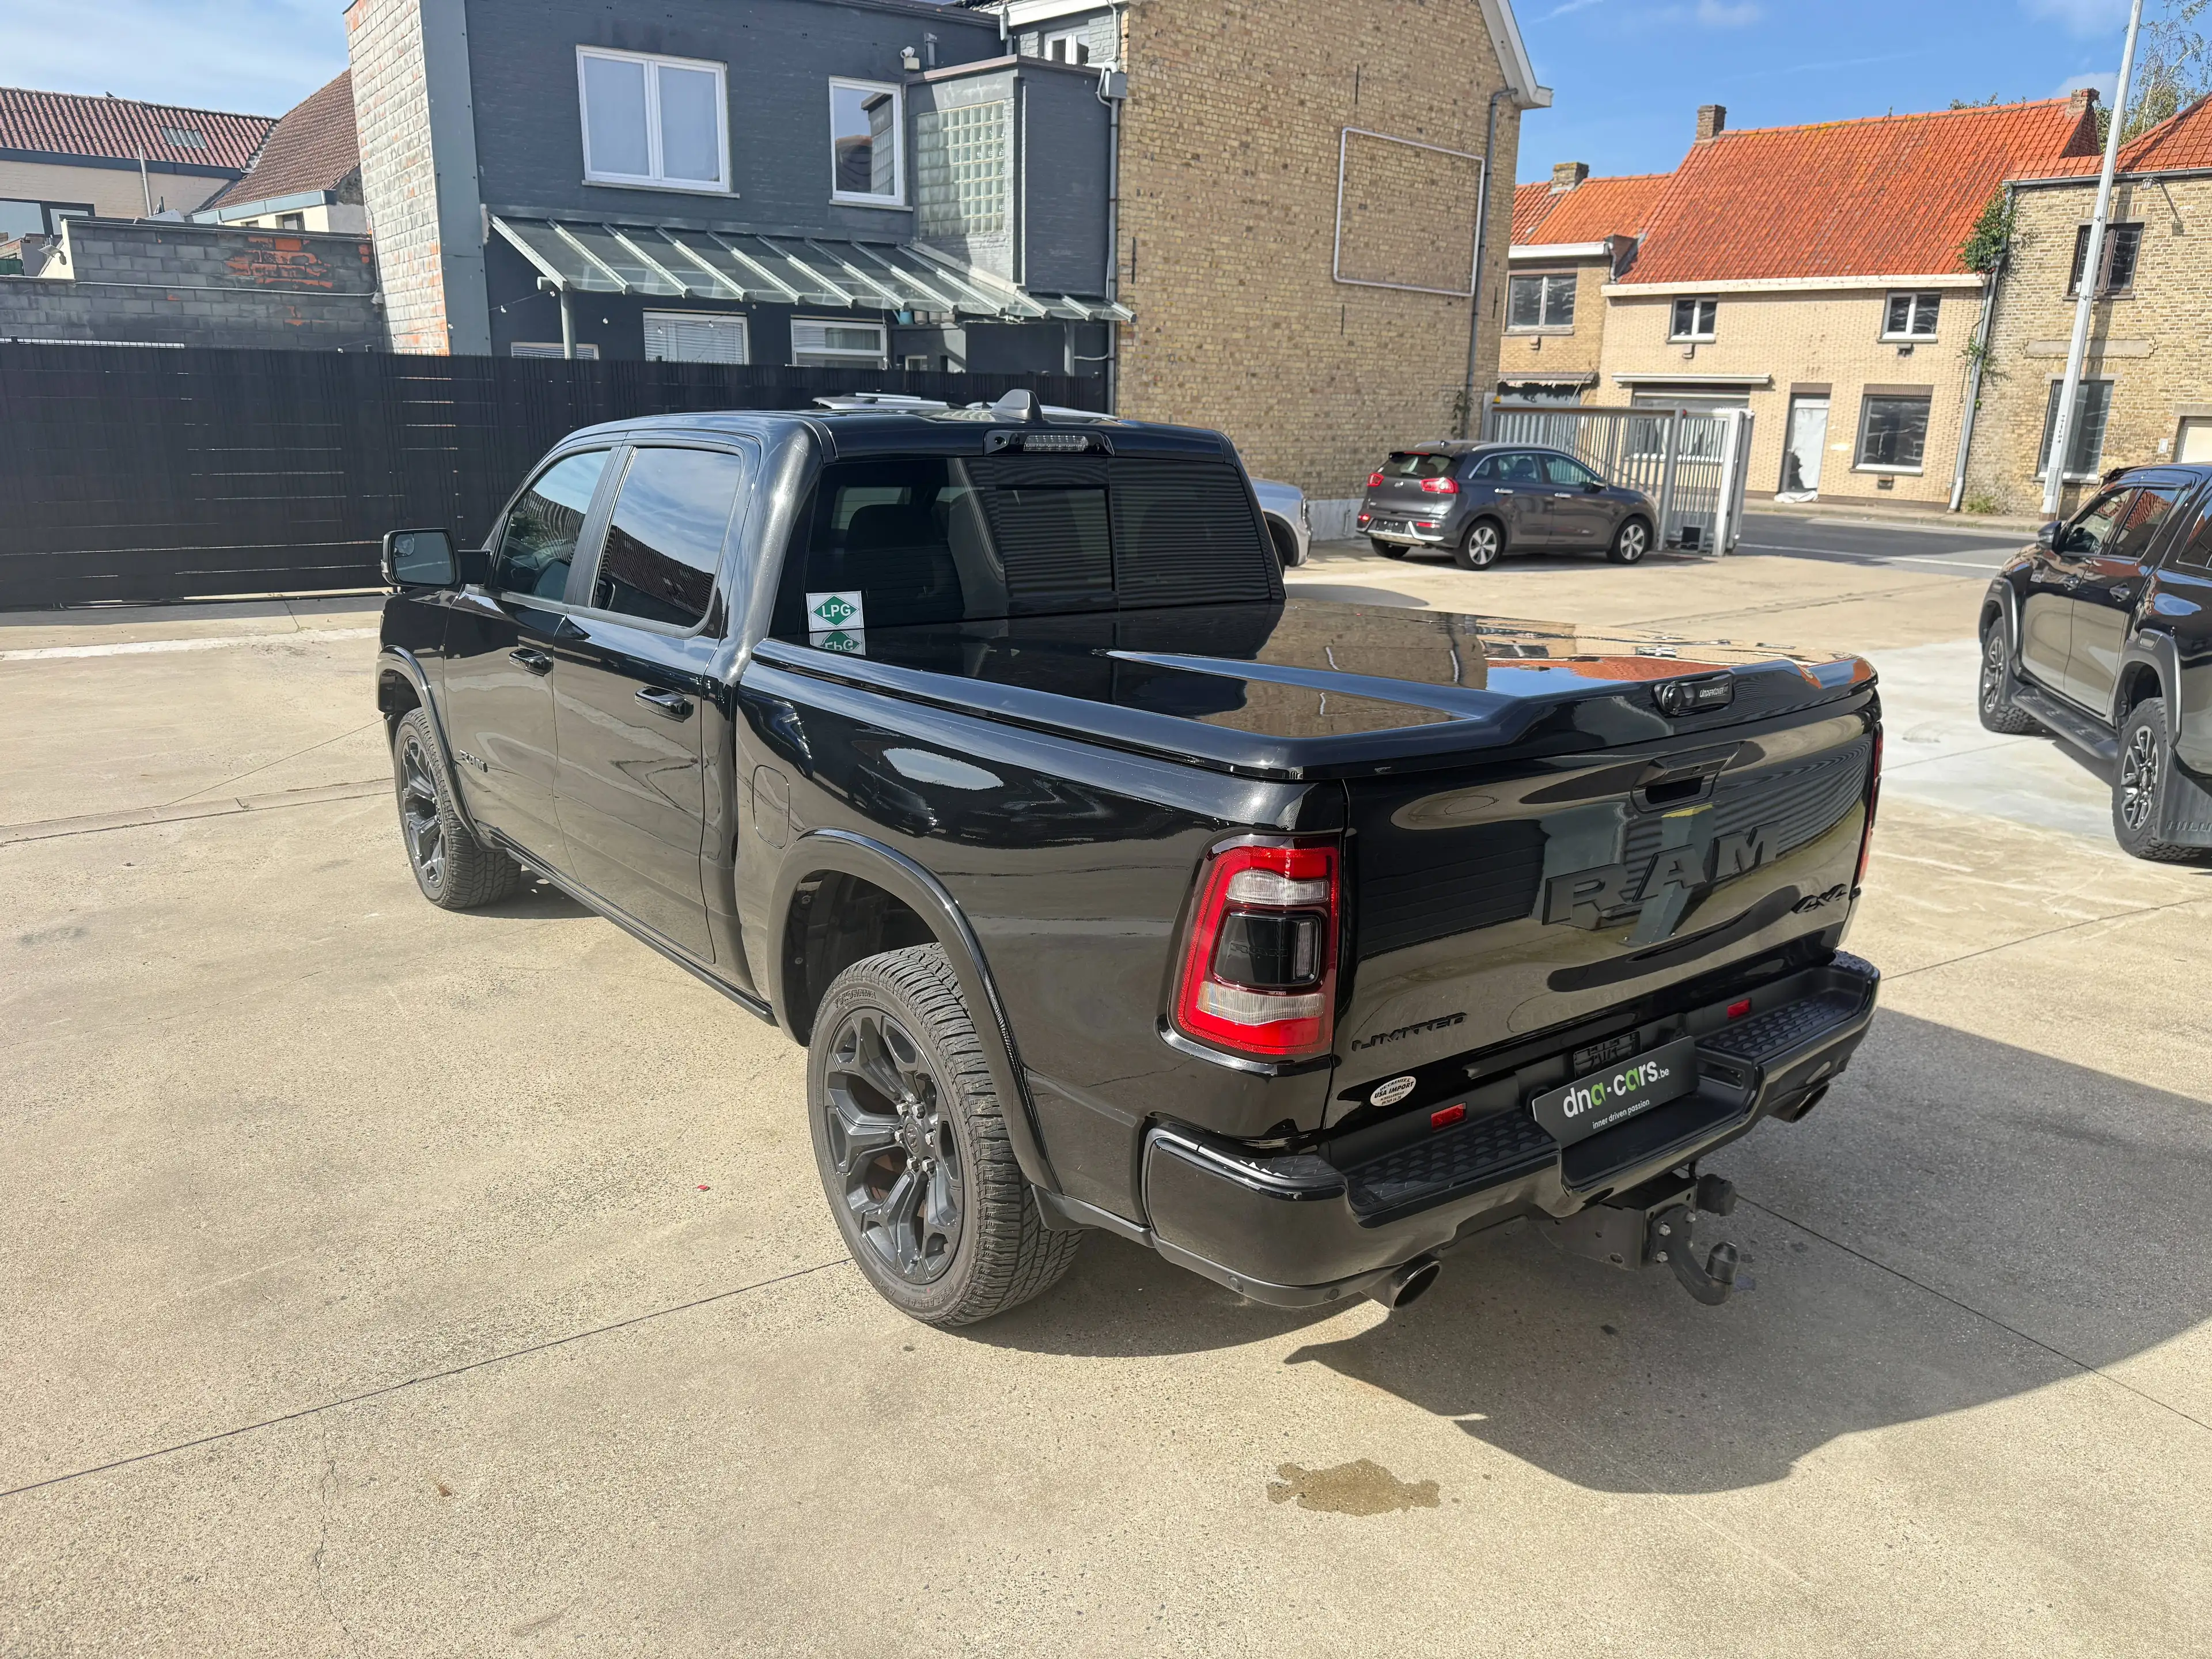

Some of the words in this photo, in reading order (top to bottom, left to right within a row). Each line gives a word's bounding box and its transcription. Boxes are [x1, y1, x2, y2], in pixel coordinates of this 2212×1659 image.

[821, 603, 851, 618] LPG
[2166, 820, 2212, 832] HILU
[1541, 820, 1781, 926] RAM
[833, 988, 877, 1009] YOKOHAMA
[1351, 1012, 1468, 1052] LIMITED
[1374, 1090, 1387, 1099] USA
[1389, 1081, 1414, 1094] IMPORT
[1592, 1118, 1607, 1129] inner
[1609, 1109, 1627, 1123] driven
[1628, 1099, 1650, 1116] passion
